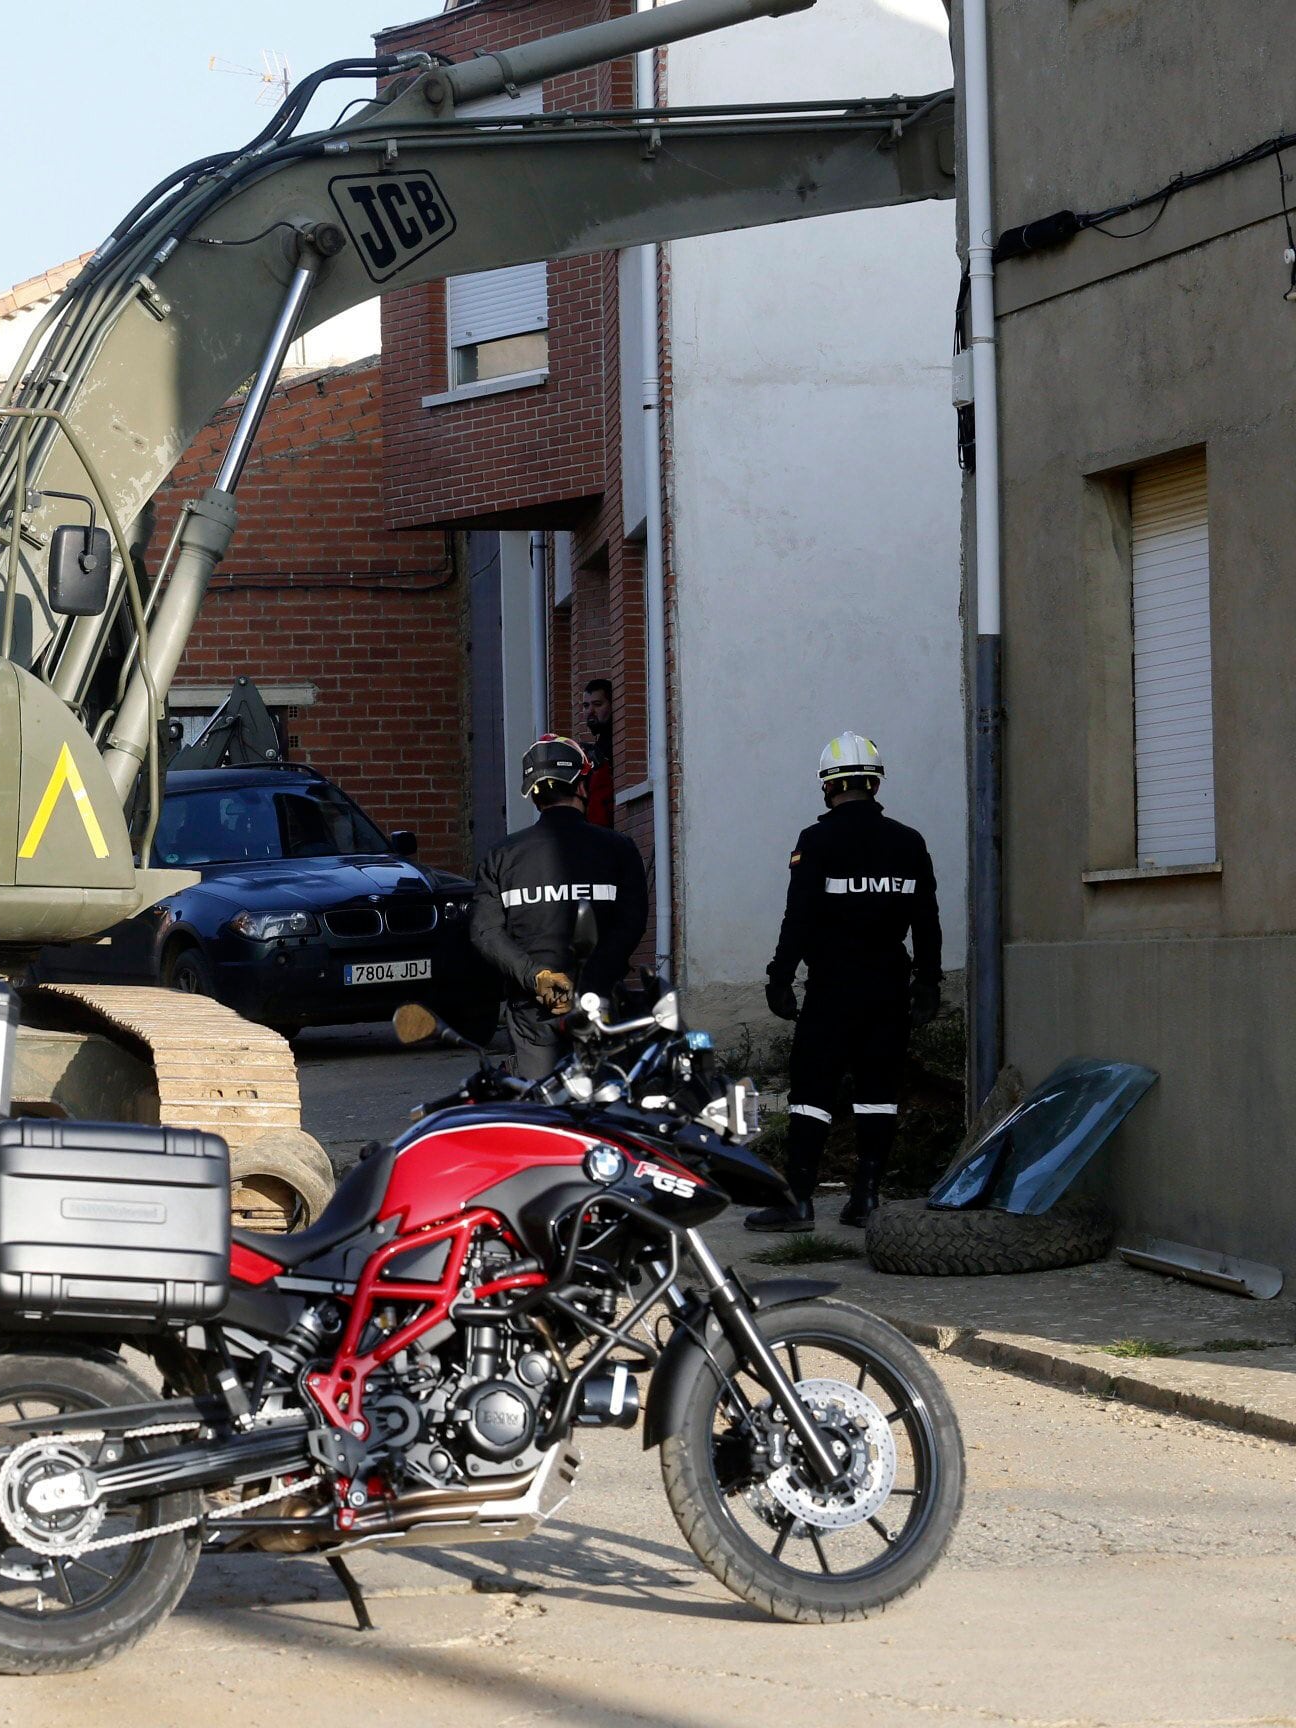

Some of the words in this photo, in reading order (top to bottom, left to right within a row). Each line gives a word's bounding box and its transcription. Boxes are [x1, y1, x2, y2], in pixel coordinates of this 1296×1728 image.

[347, 180, 445, 269] JCB
[522, 884, 591, 904] UME
[848, 876, 903, 893] UME
[356, 964, 394, 982] 7804
[400, 960, 428, 978] JDJ
[652, 1171, 698, 1199] GS
